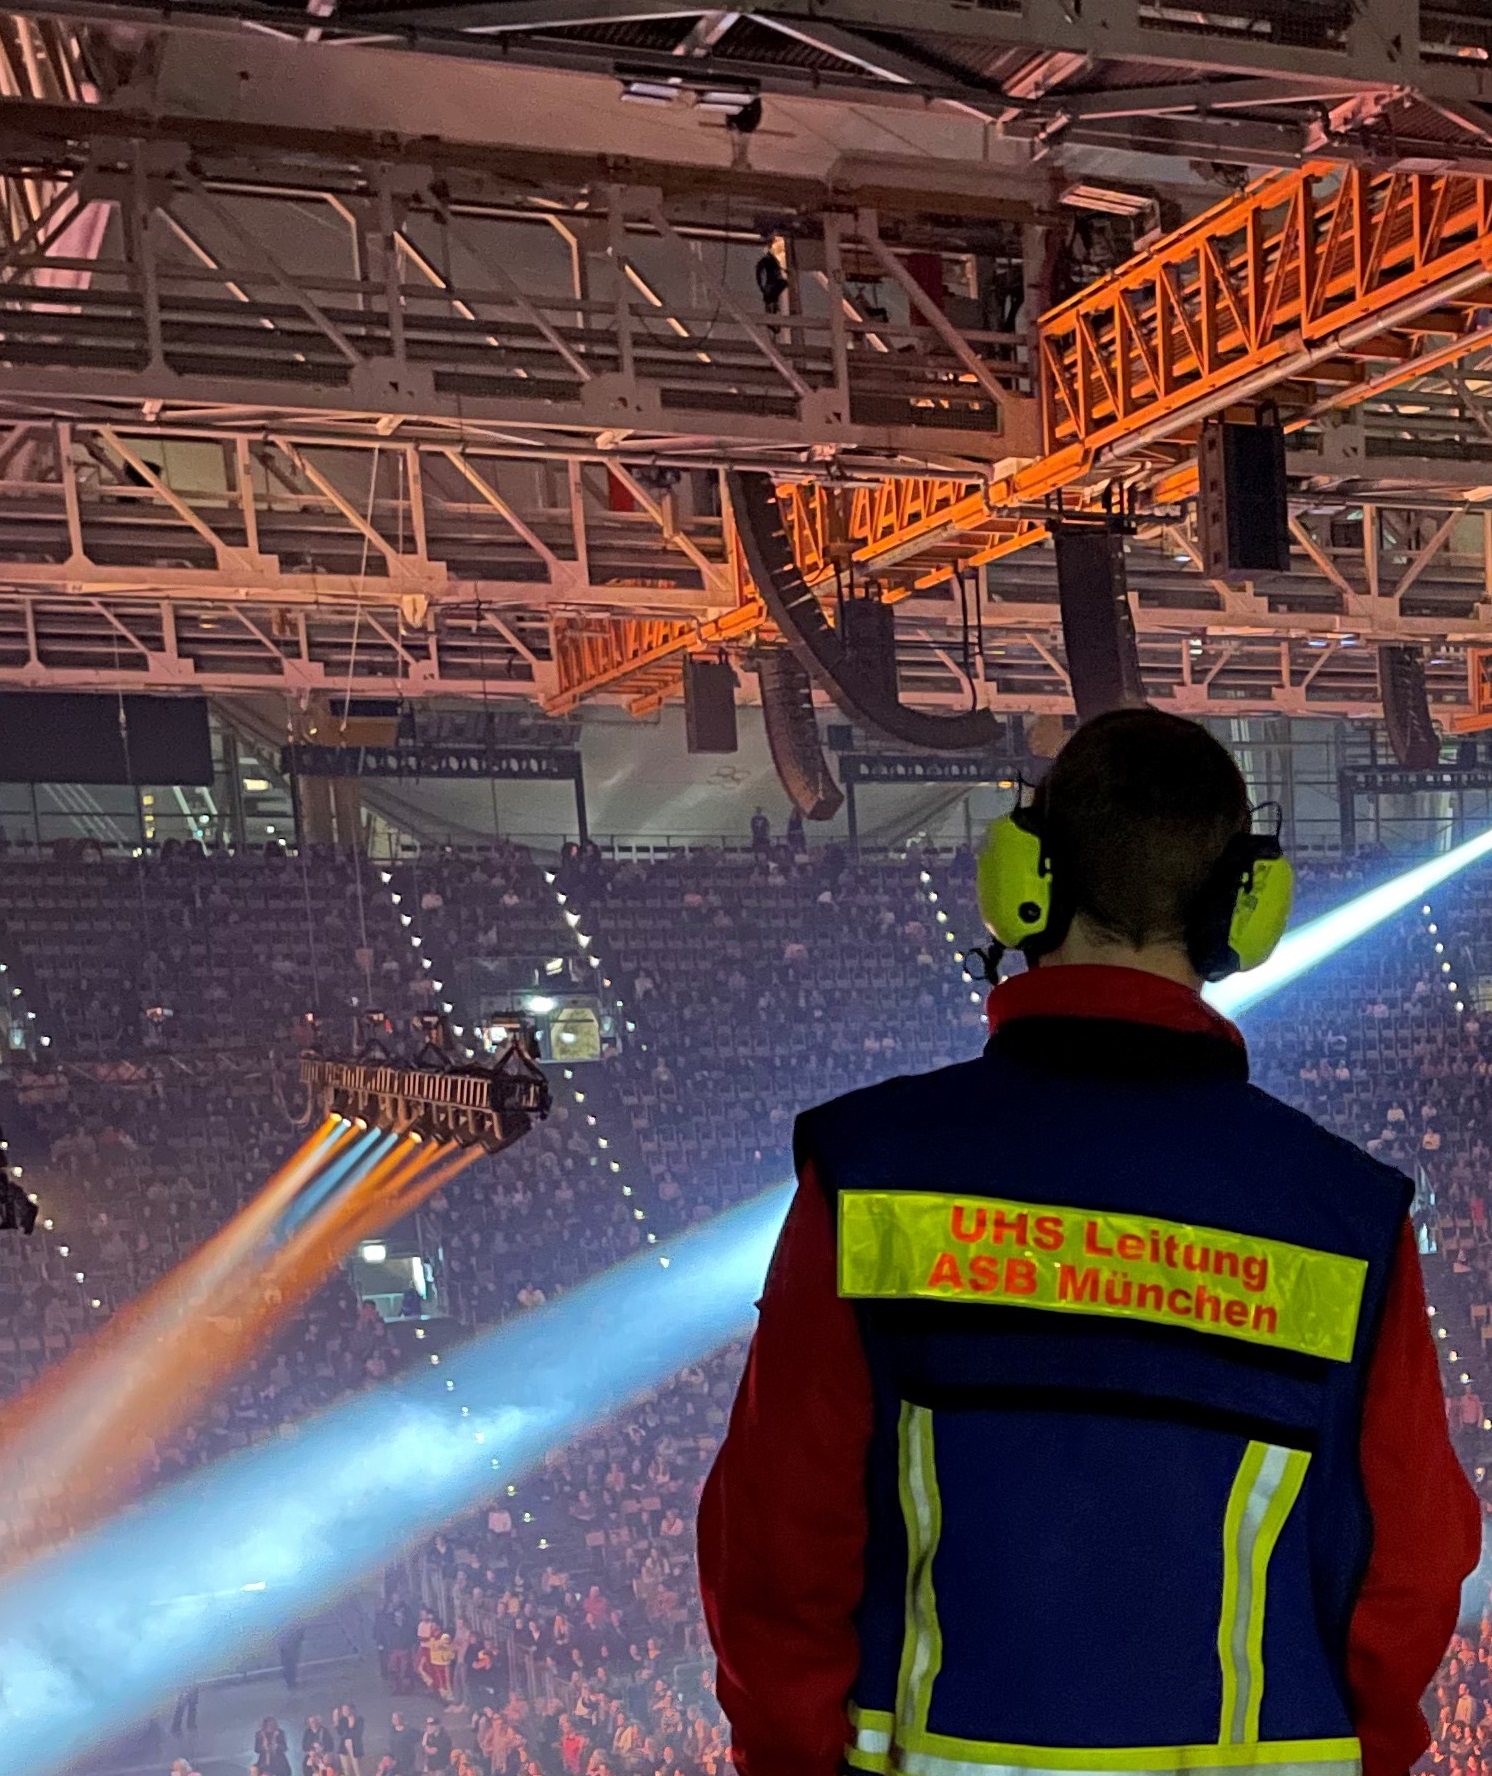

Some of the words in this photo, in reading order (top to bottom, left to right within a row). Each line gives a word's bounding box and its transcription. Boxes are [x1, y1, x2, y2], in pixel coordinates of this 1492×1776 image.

[950, 1205, 1065, 1251] UHS
[1084, 1221, 1268, 1293] Leitung
[927, 1252, 1038, 1296] ASB
[1057, 1263, 1278, 1333] München
